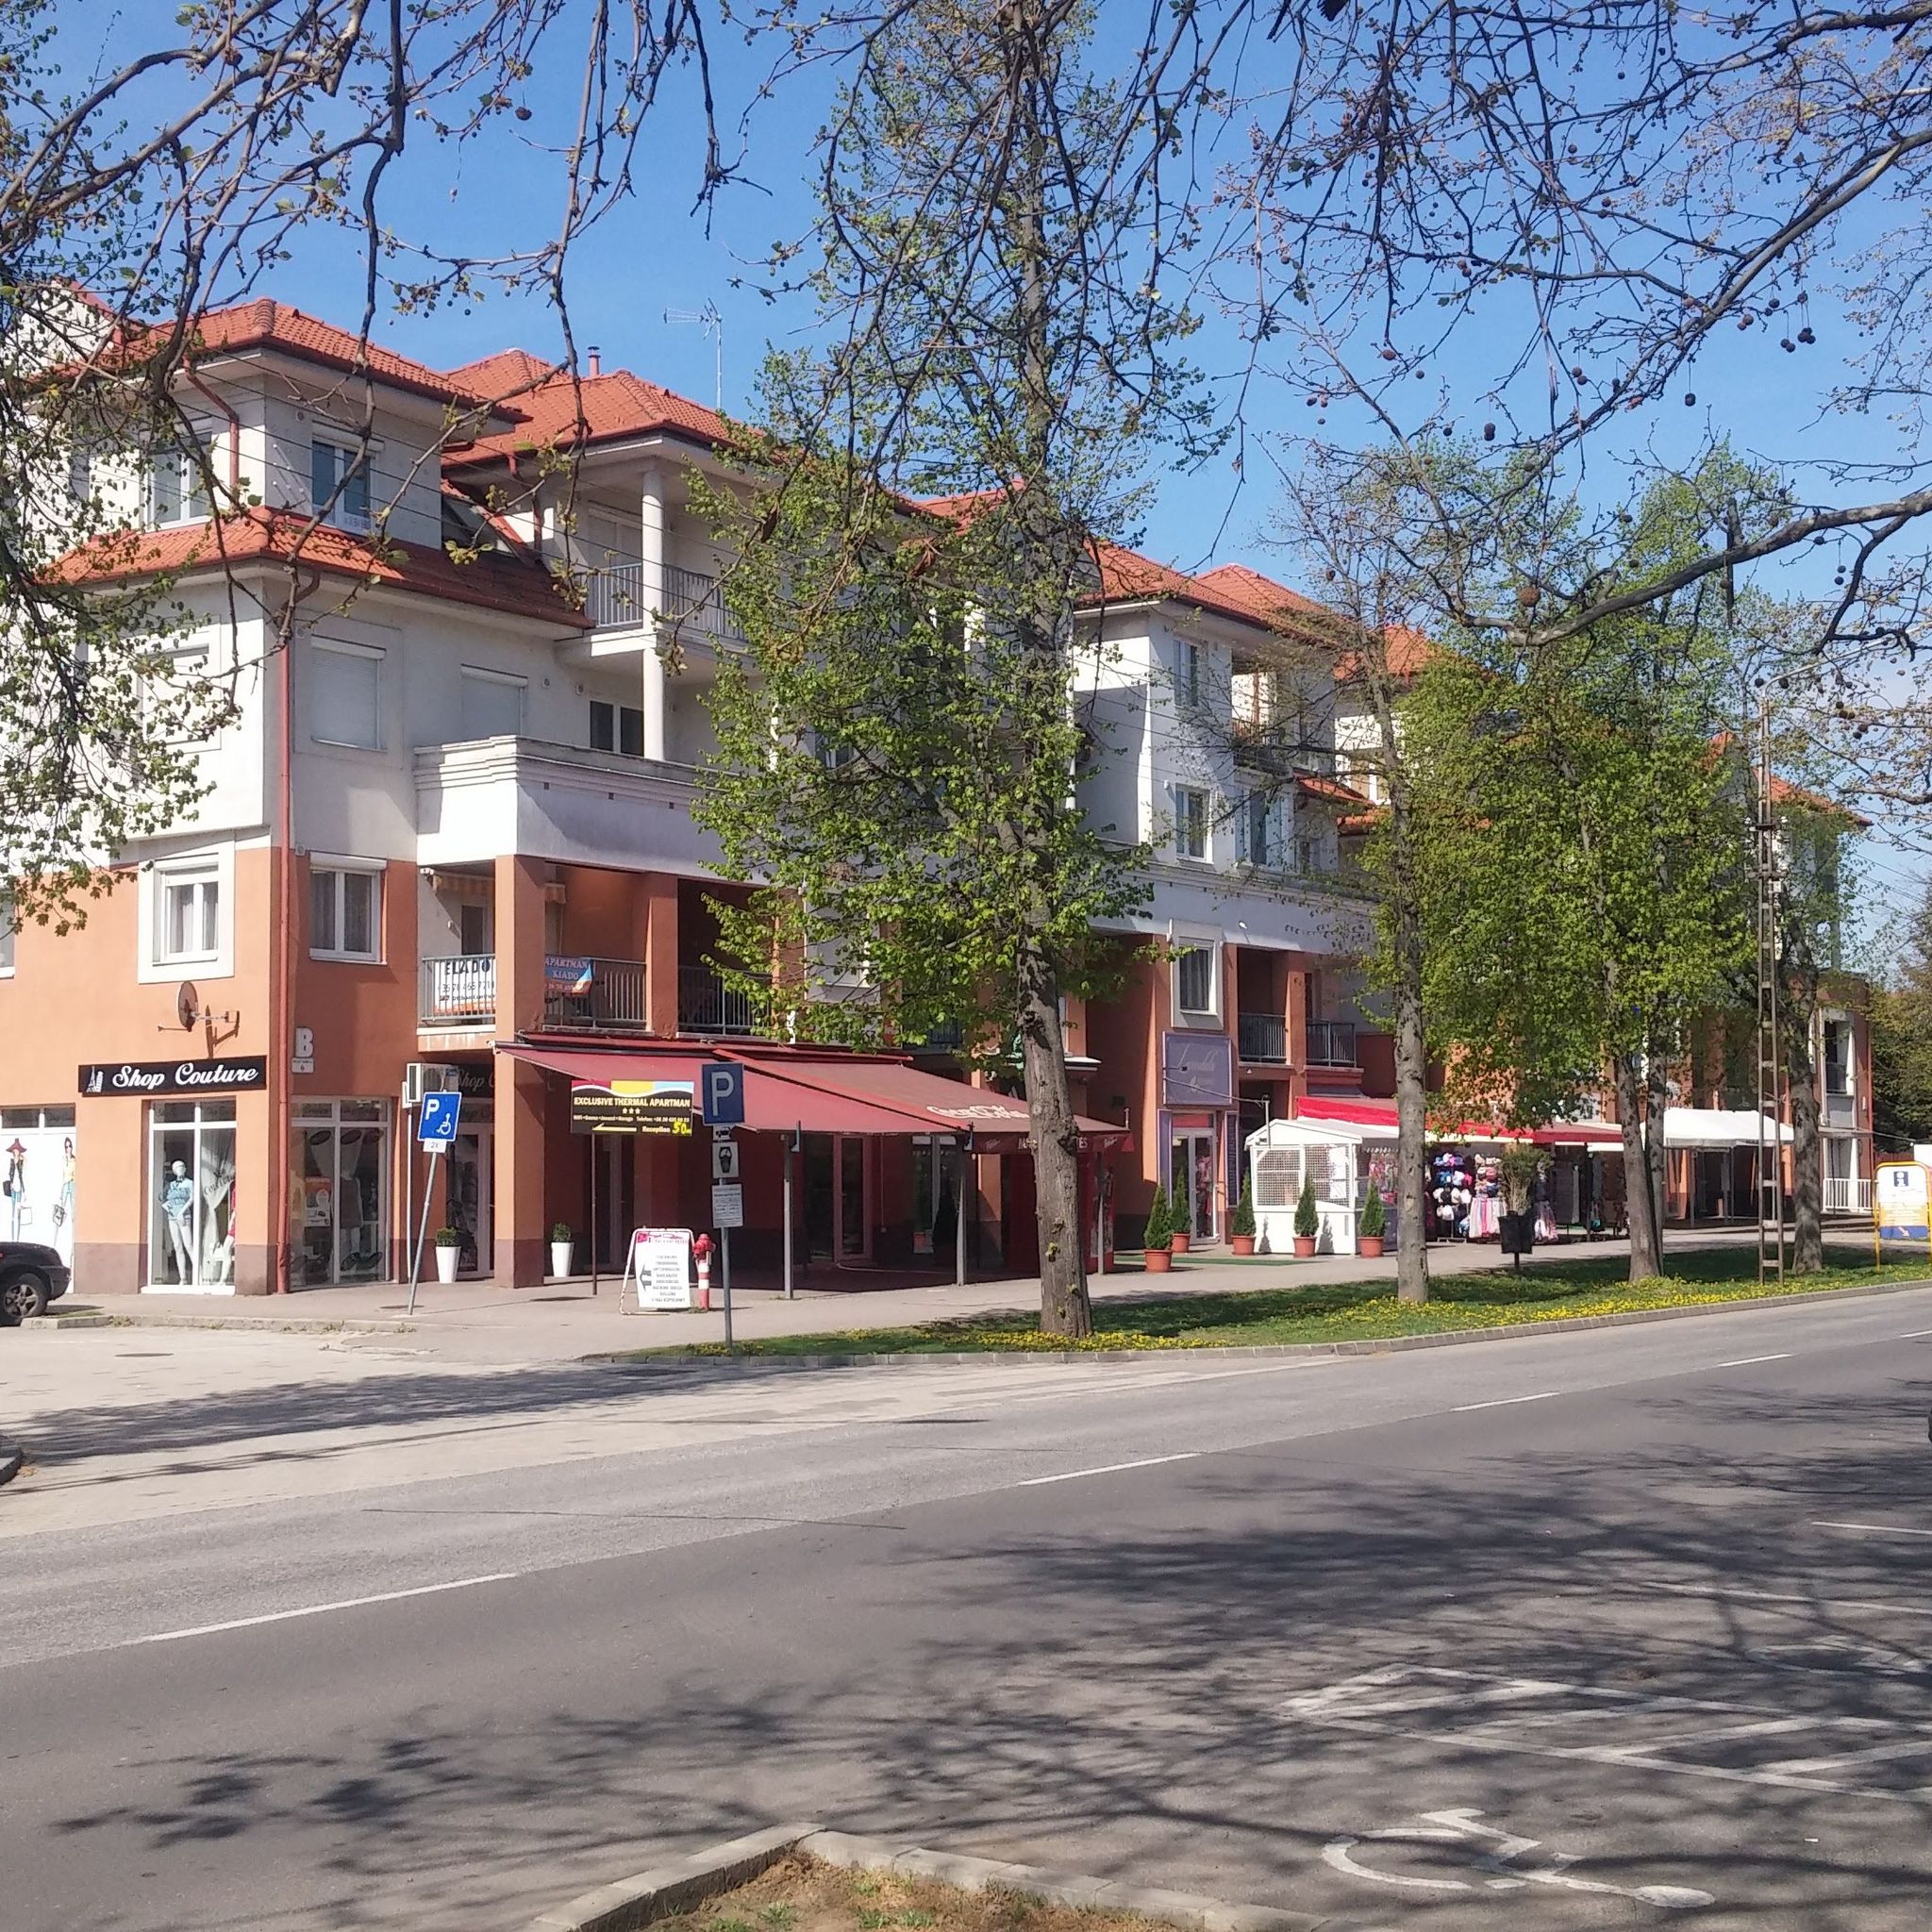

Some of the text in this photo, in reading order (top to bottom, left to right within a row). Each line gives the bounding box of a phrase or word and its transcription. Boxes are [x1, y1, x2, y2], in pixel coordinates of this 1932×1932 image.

[295, 1026, 314, 1058] B
[111, 1061, 259, 1091] Shop Couture
[573, 1096, 691, 1108] EXCLUSIVE THERMAL APARTMAN
[711, 1071, 735, 1117] P
[425, 1099, 441, 1121] P
